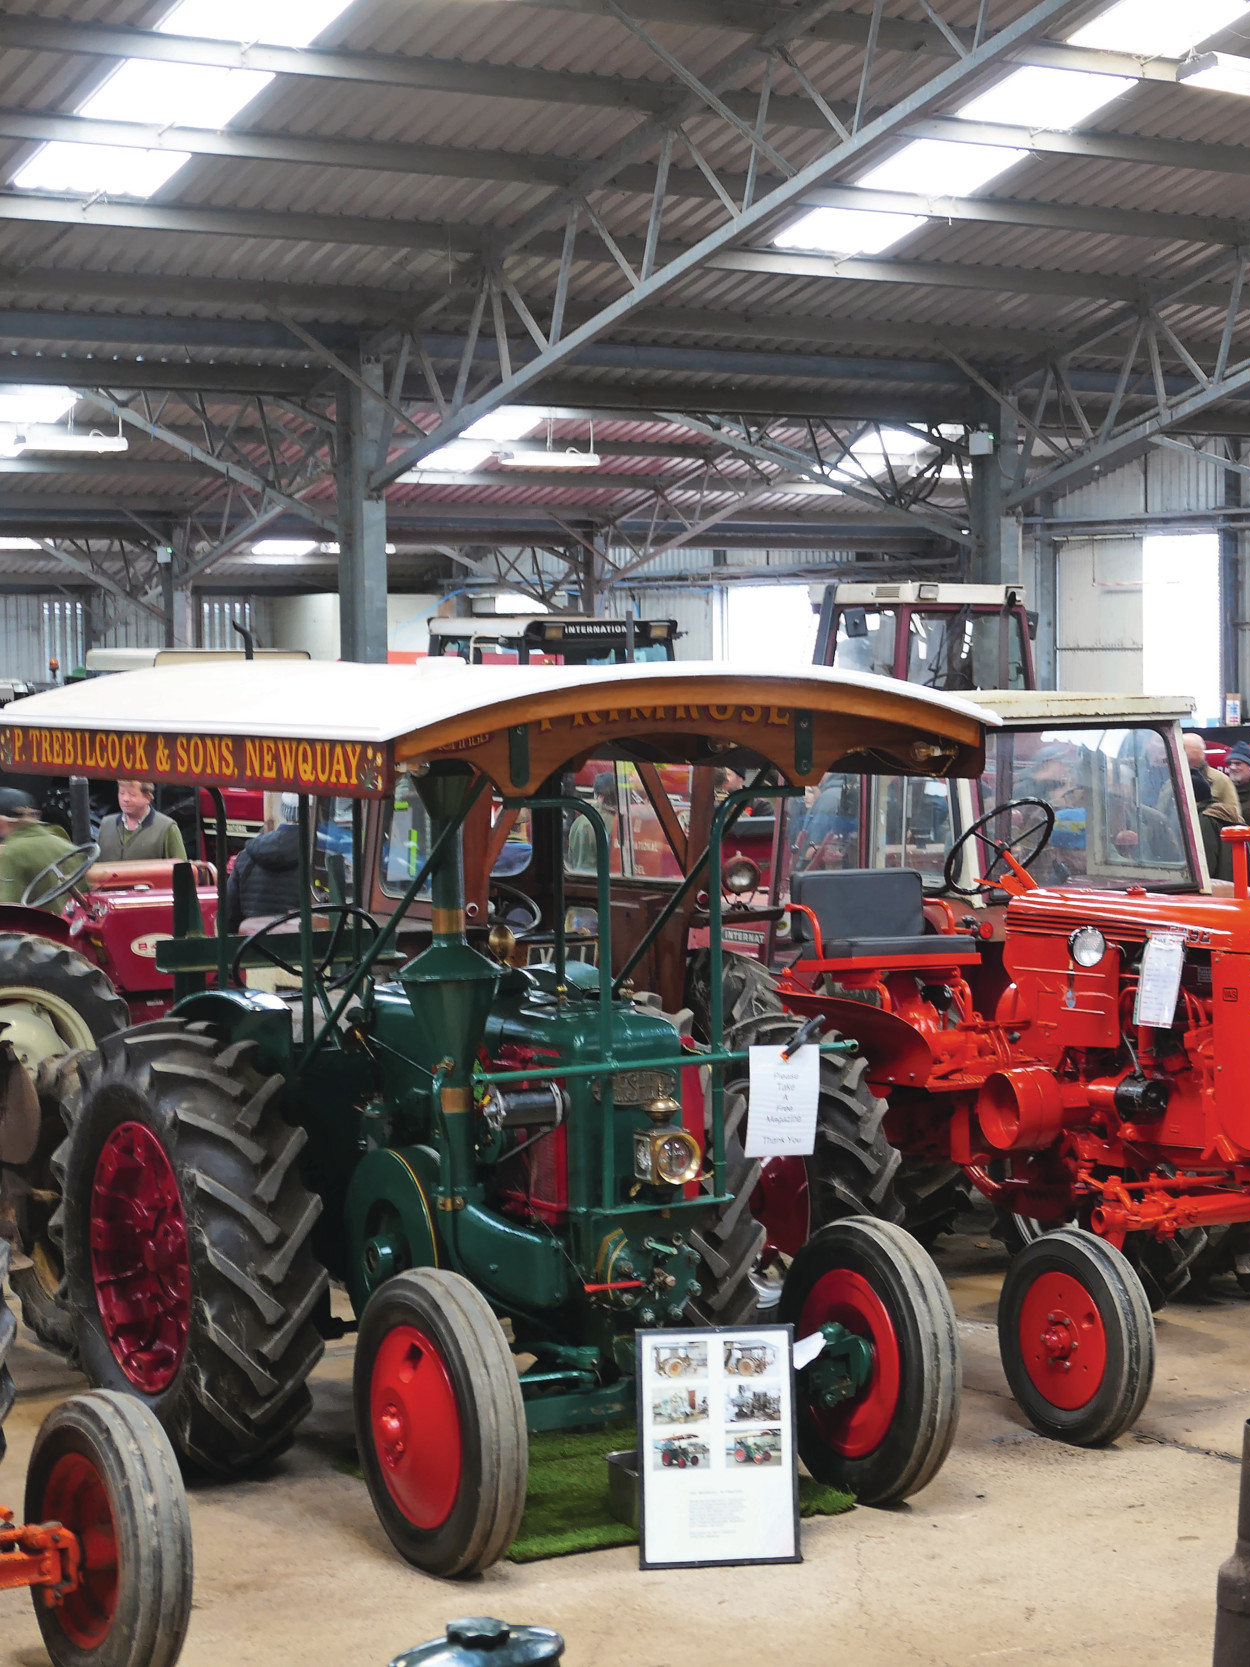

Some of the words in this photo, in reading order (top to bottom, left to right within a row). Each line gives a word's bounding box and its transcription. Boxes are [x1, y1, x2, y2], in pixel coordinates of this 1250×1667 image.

[564, 625, 640, 634] INTERNATIONL
[14, 729, 26, 762] P.
[29, 729, 149, 771] TREBILCOCK
[156, 735, 171, 773] &
[176, 735, 239, 779] SONS,
[245, 739, 363, 785] NEWQUAY
[724, 930, 764, 944] INTERNAT
[1168, 924, 1211, 944] SE
[773, 1072, 799, 1080] Please
[777, 1083, 795, 1091] Take
[766, 1115, 801, 1124] Magazine
[762, 1136, 785, 1144] Thank
[788, 1136, 801, 1144] You
